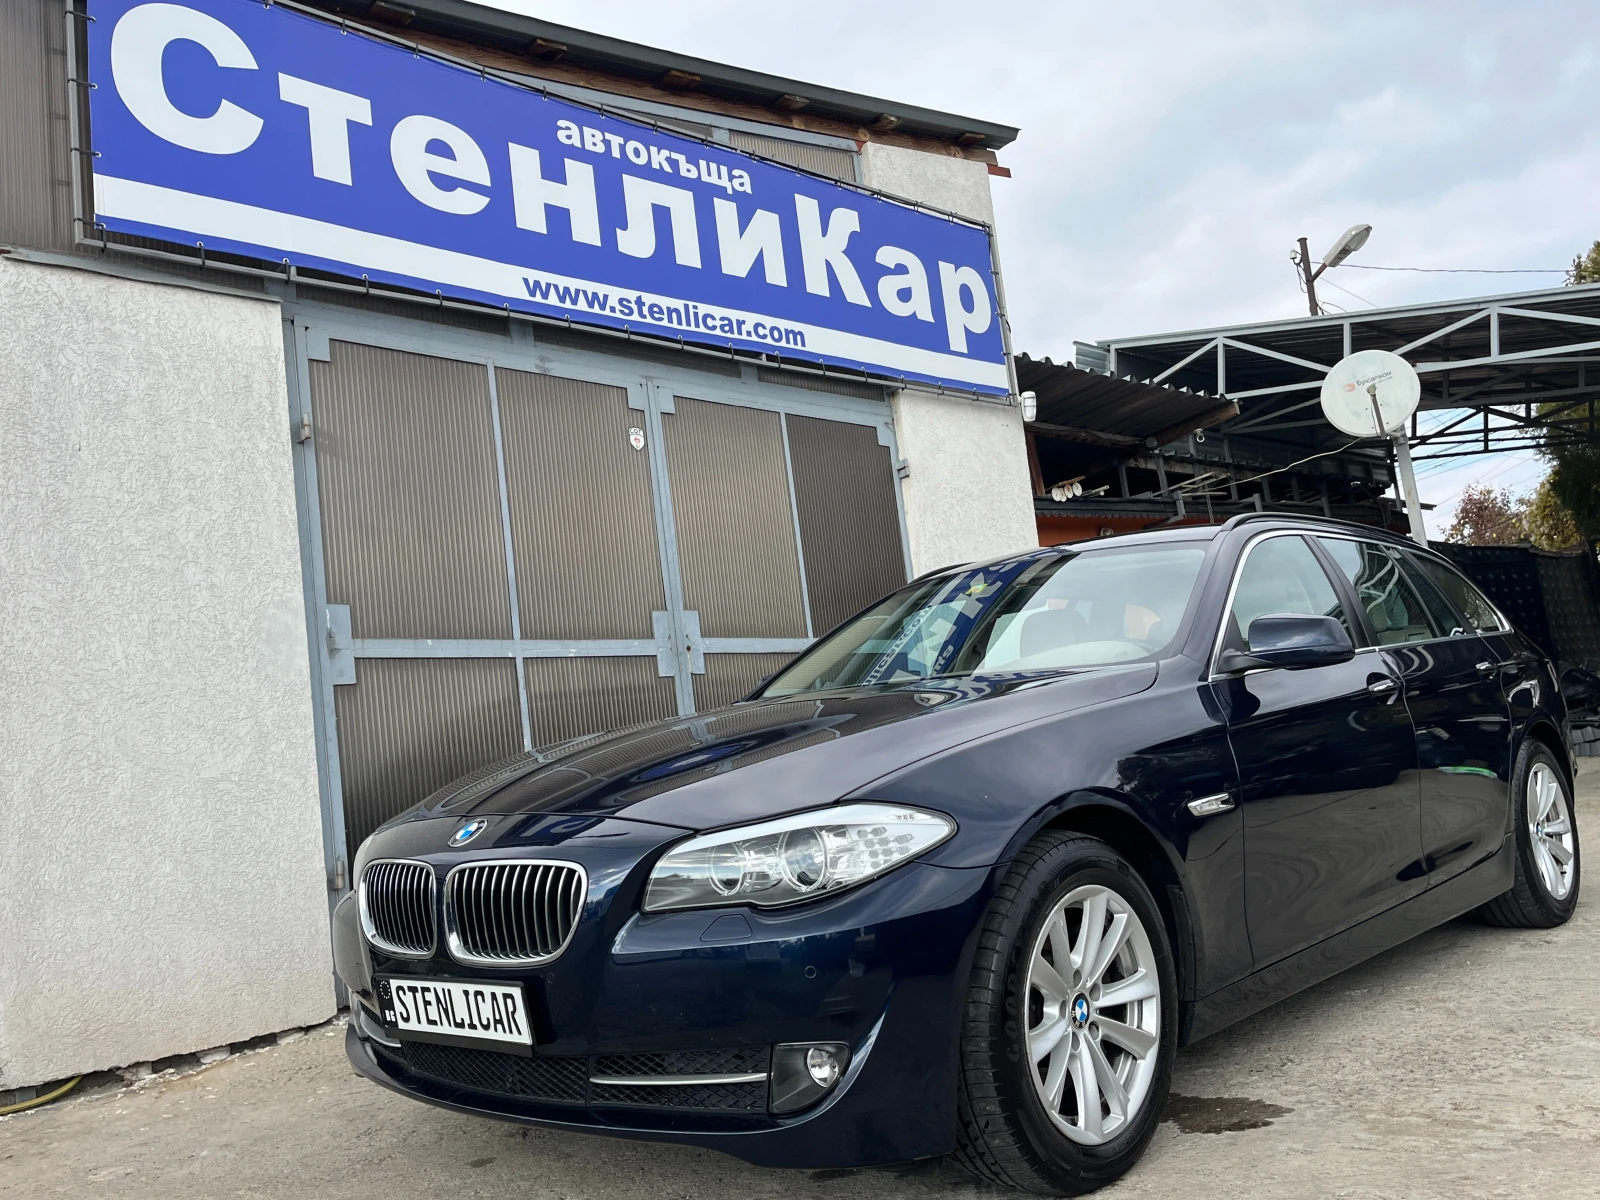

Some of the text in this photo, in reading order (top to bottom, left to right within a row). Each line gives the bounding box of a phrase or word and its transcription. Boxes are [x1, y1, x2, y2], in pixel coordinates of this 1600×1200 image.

[110, 3, 992, 354] СтенлиКар
[556, 119, 753, 195] автокъща
[522, 277, 807, 349] www.stenlicar.com
[385, 1009, 396, 1022] BG
[395, 985, 522, 1036] STENLICAR
